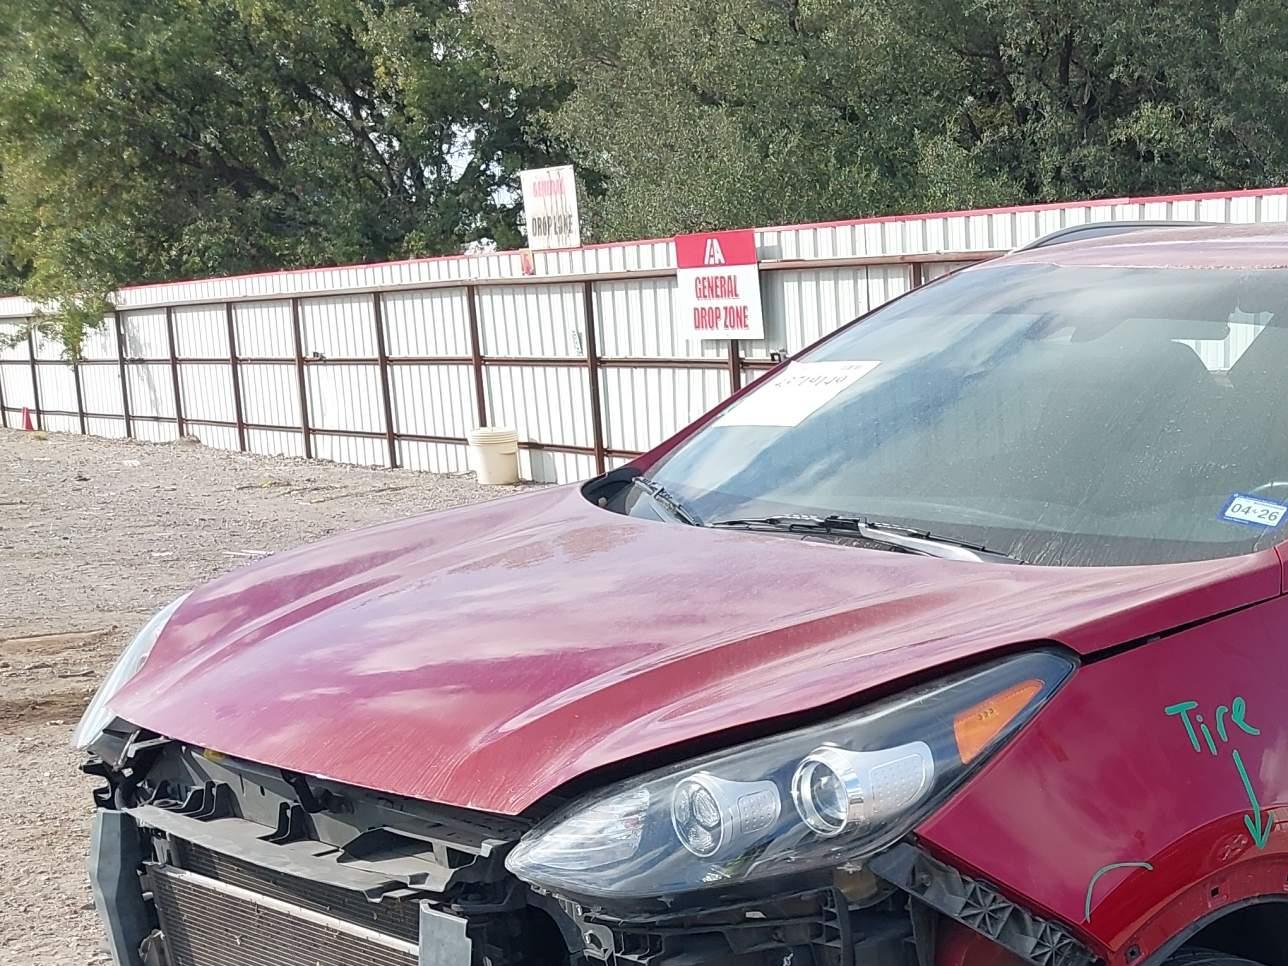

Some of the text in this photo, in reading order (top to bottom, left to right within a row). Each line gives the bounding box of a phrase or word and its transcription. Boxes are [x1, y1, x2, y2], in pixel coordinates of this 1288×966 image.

[694, 274, 740, 300] GENERAL
[694, 305, 750, 331] DROP ZONE
[1164, 696, 1260, 756] Tire
